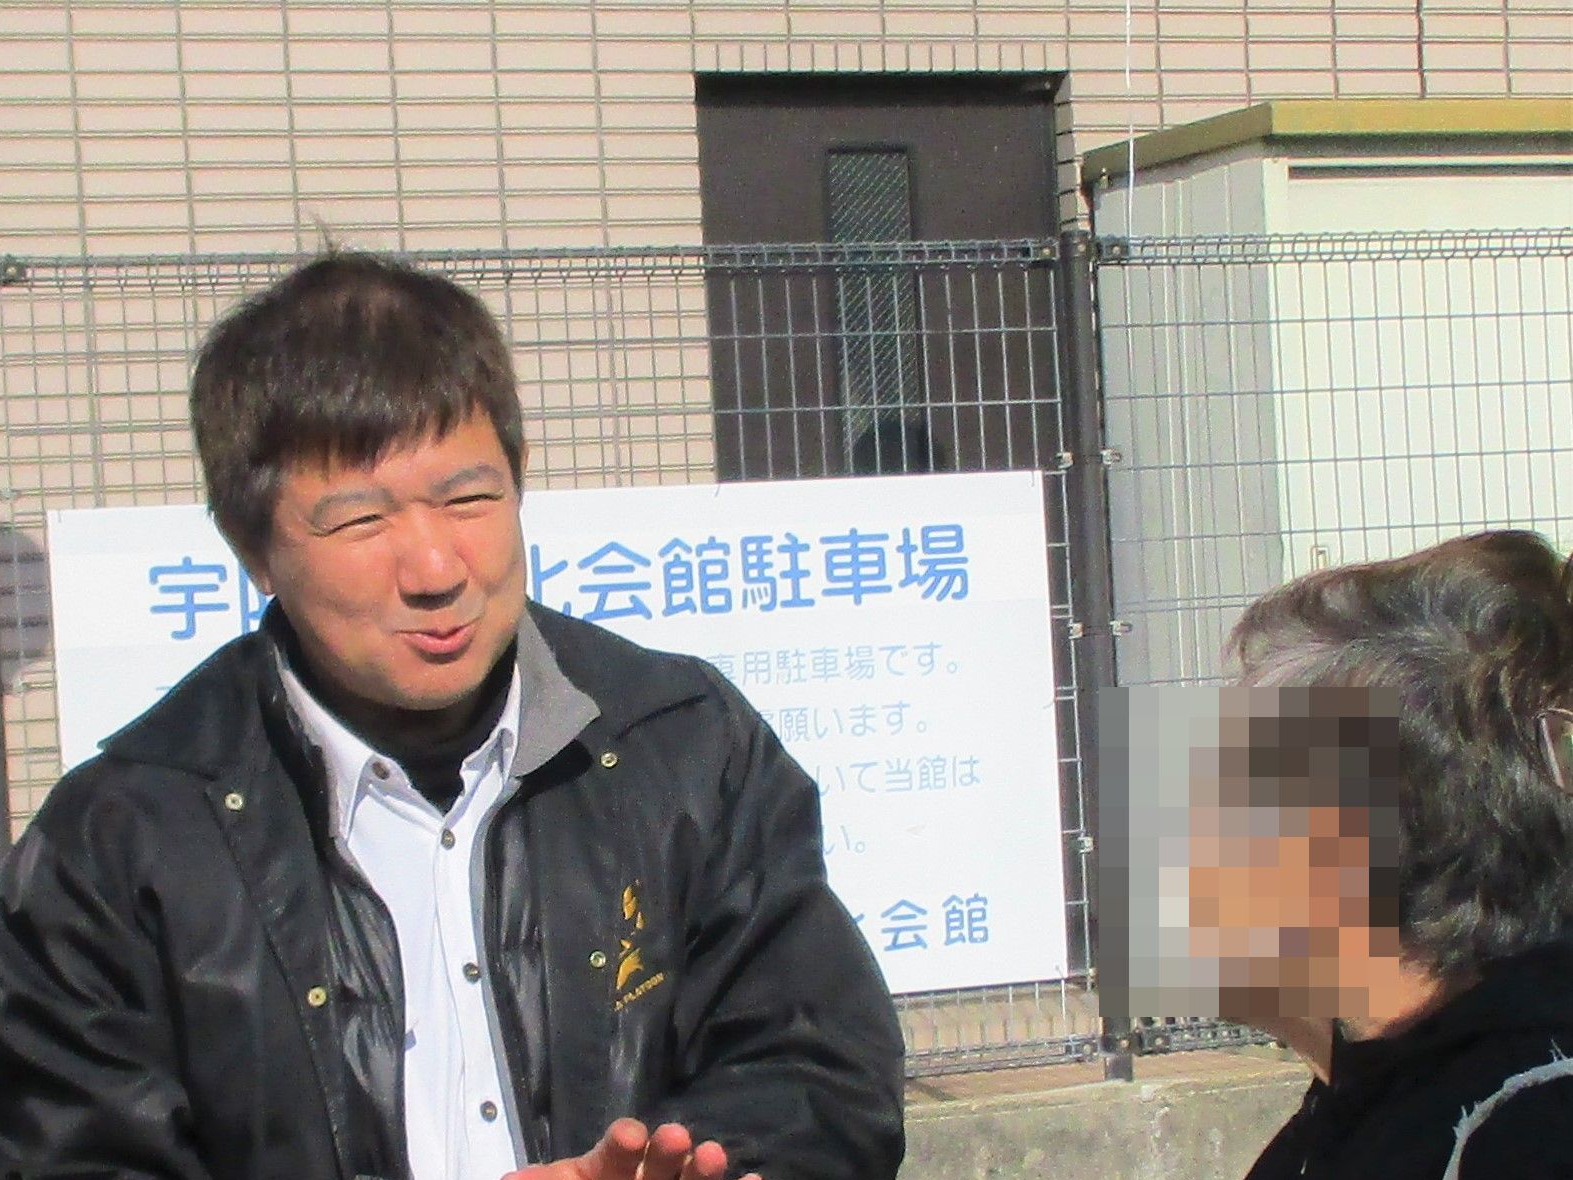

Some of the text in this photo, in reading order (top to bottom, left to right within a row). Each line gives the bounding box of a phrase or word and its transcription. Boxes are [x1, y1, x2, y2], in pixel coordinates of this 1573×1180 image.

[760, 700, 928, 742] 願います。
[854, 893, 989, 952] 会館
